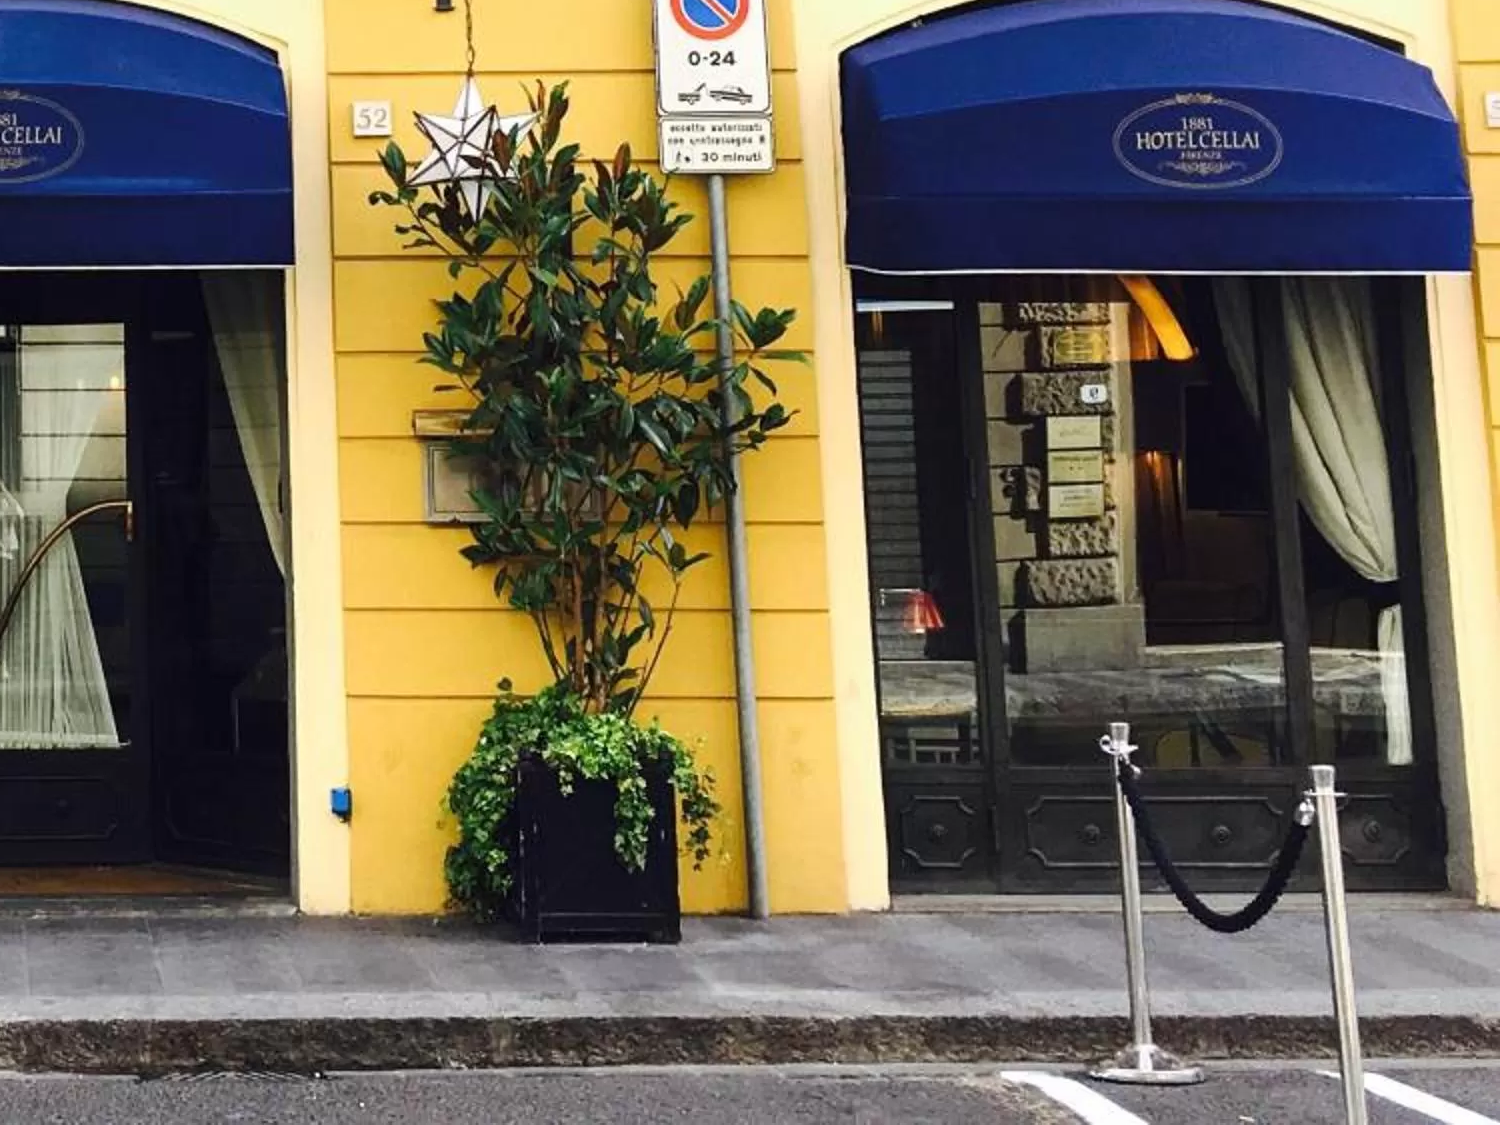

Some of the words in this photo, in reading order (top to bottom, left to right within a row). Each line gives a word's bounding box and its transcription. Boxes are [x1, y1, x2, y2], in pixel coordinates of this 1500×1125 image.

[687, 50, 736, 67] 0-24
[356, 107, 388, 129] 52
[1181, 117, 1213, 130] 1881
[722, 150, 763, 162] minuti
